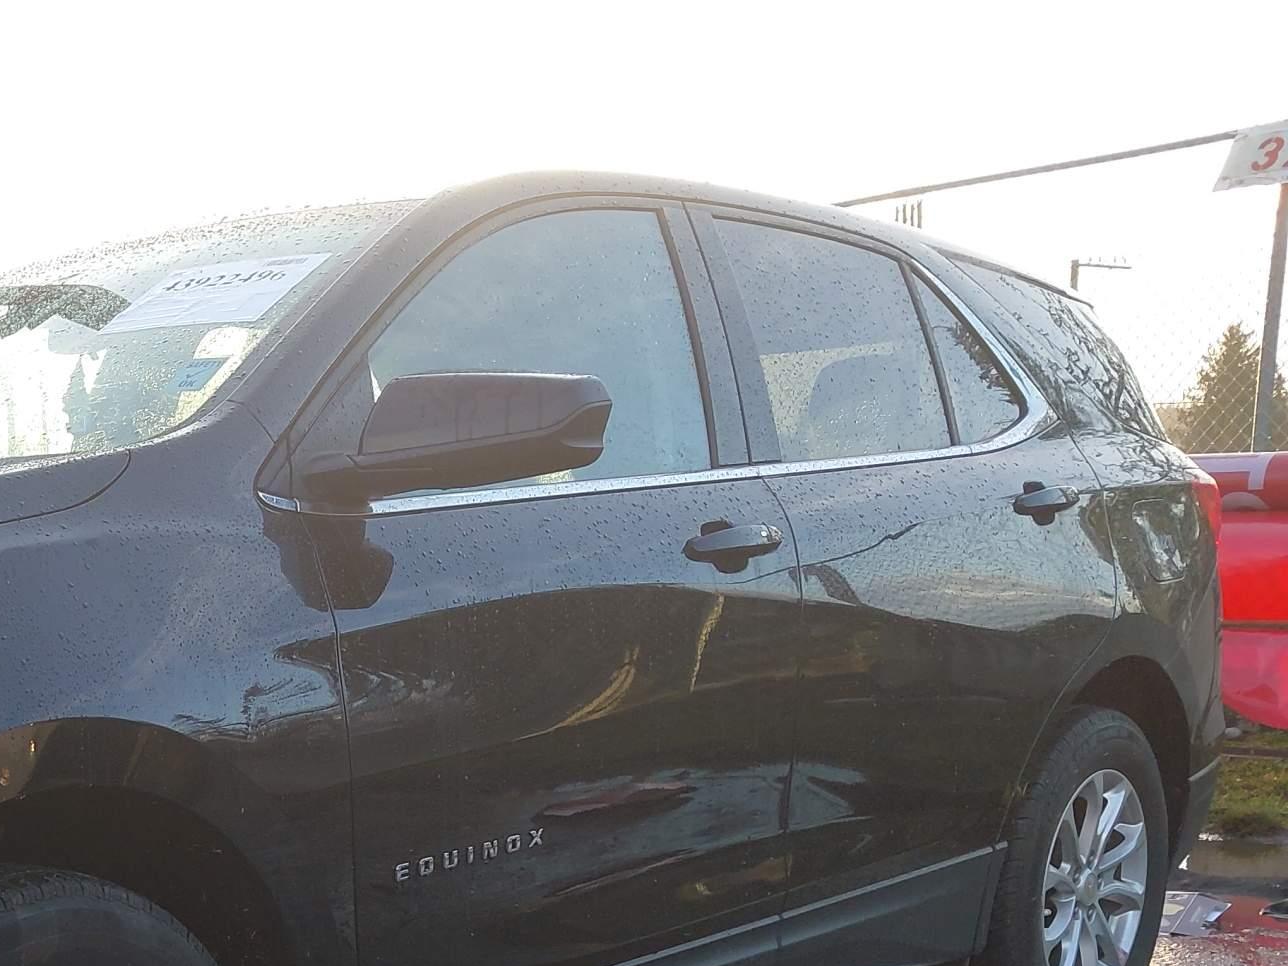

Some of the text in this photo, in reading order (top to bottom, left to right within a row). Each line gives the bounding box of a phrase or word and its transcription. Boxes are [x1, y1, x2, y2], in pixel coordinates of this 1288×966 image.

[1250, 136, 1288, 172] 3
[162, 269, 287, 292] 43922496
[395, 828, 545, 883] EQUINOX
